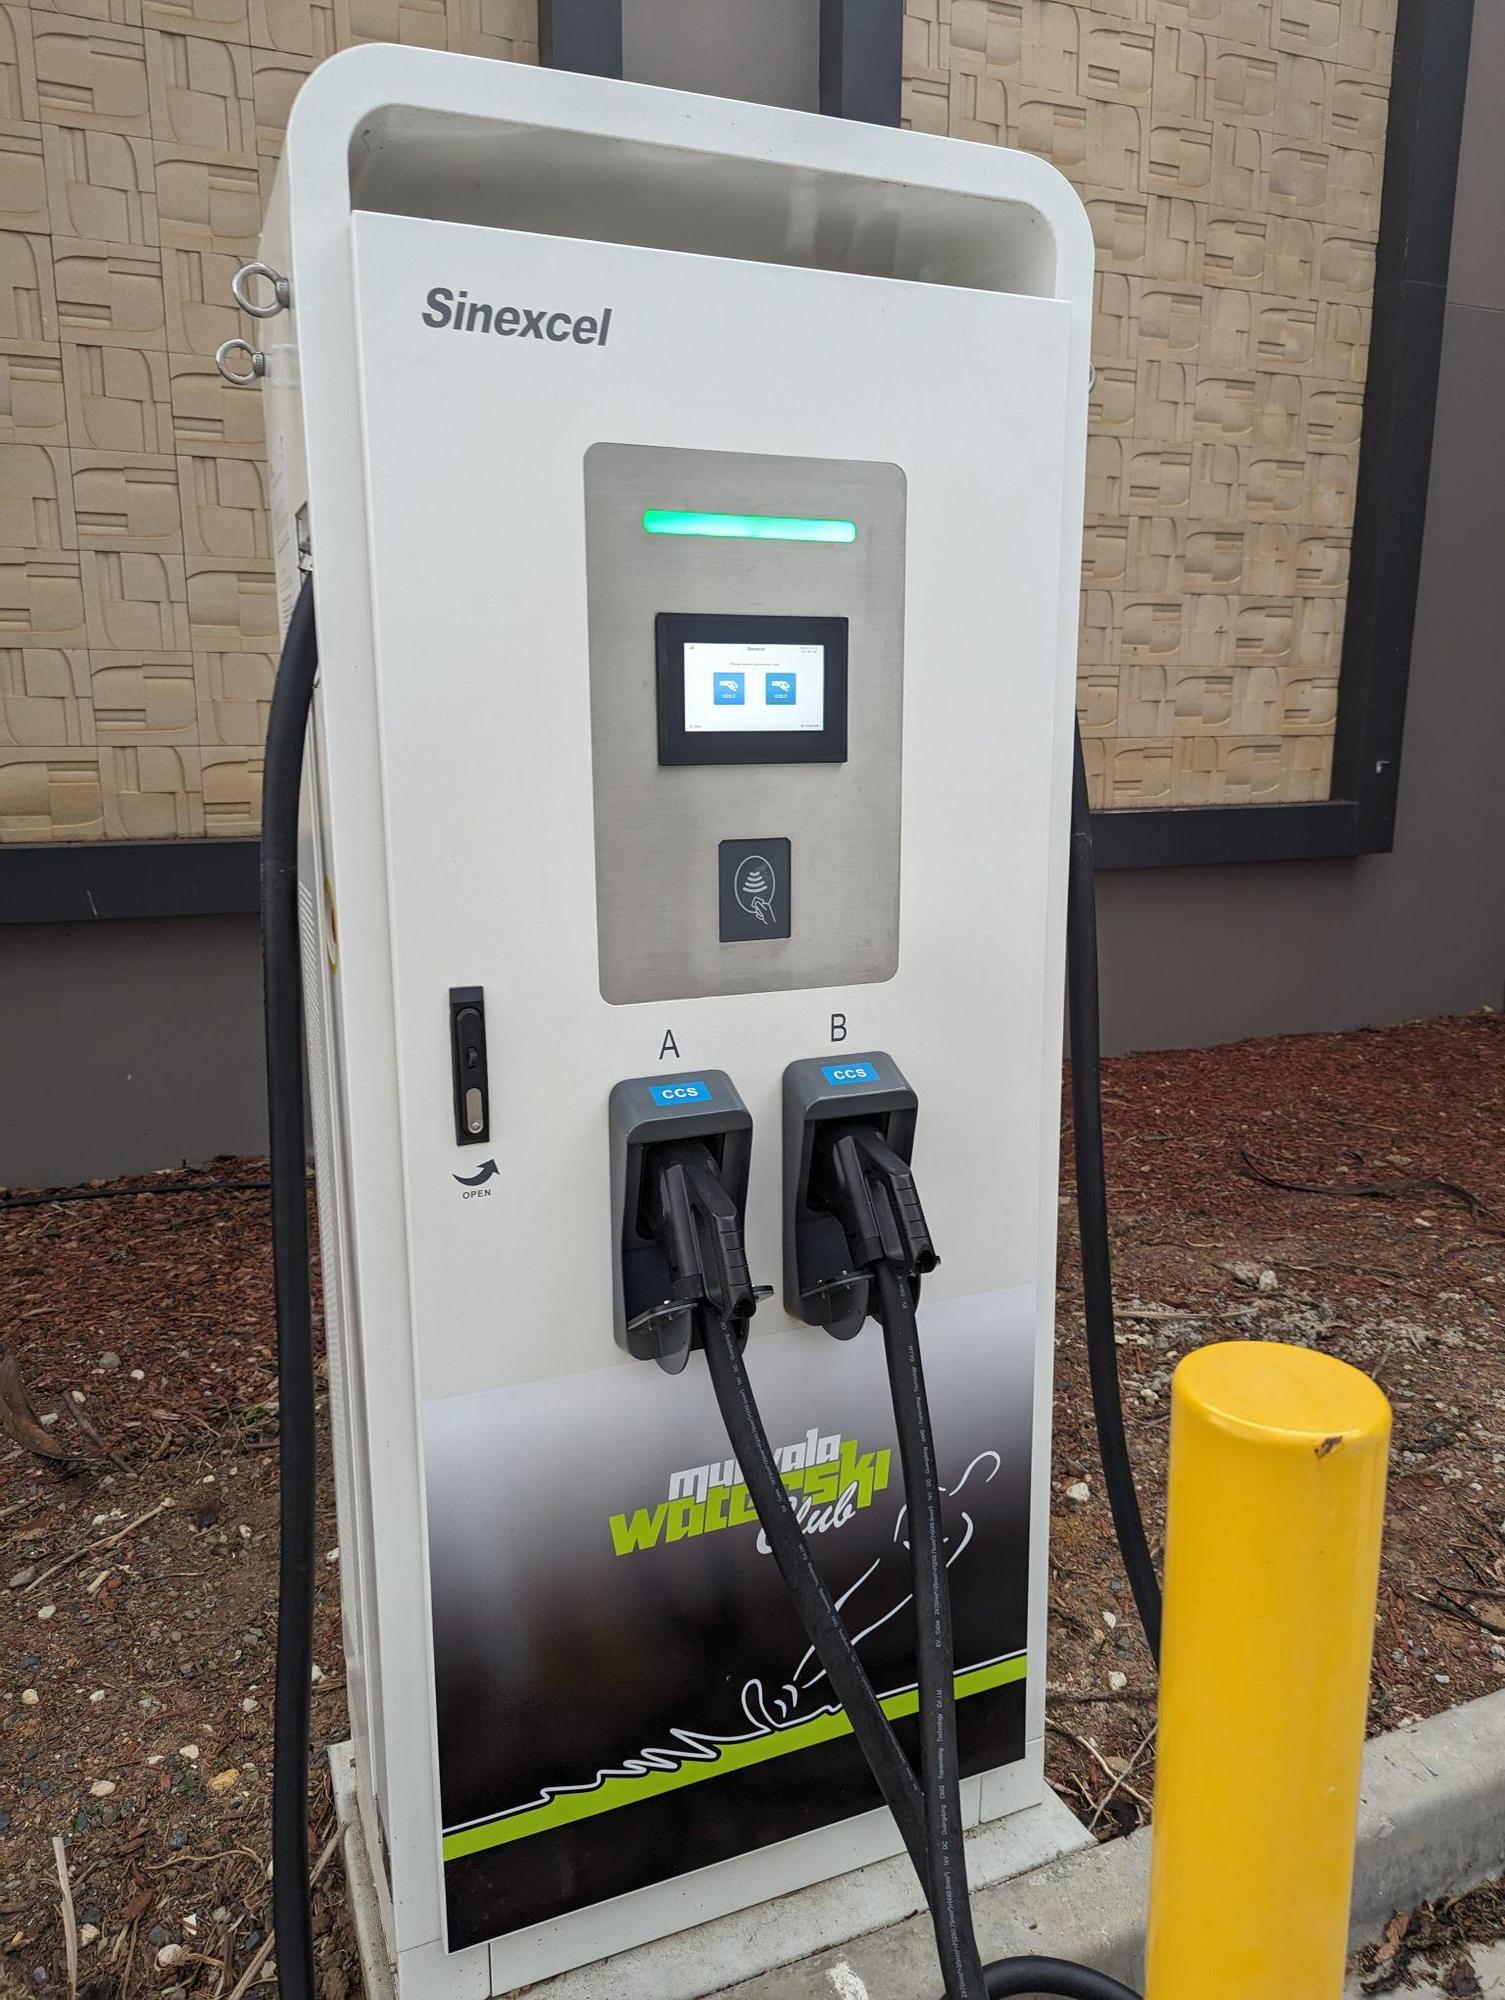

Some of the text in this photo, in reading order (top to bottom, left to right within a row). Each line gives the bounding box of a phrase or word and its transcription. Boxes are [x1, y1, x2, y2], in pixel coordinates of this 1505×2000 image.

[422, 287, 612, 346] Sinexcel
[830, 1013, 847, 1042] B
[659, 1029, 680, 1060] A
[833, 1067, 867, 1081] CCS
[662, 1086, 699, 1100] CCS
[462, 1189, 491, 1200] OPEN
[668, 1428, 841, 1503] muala
